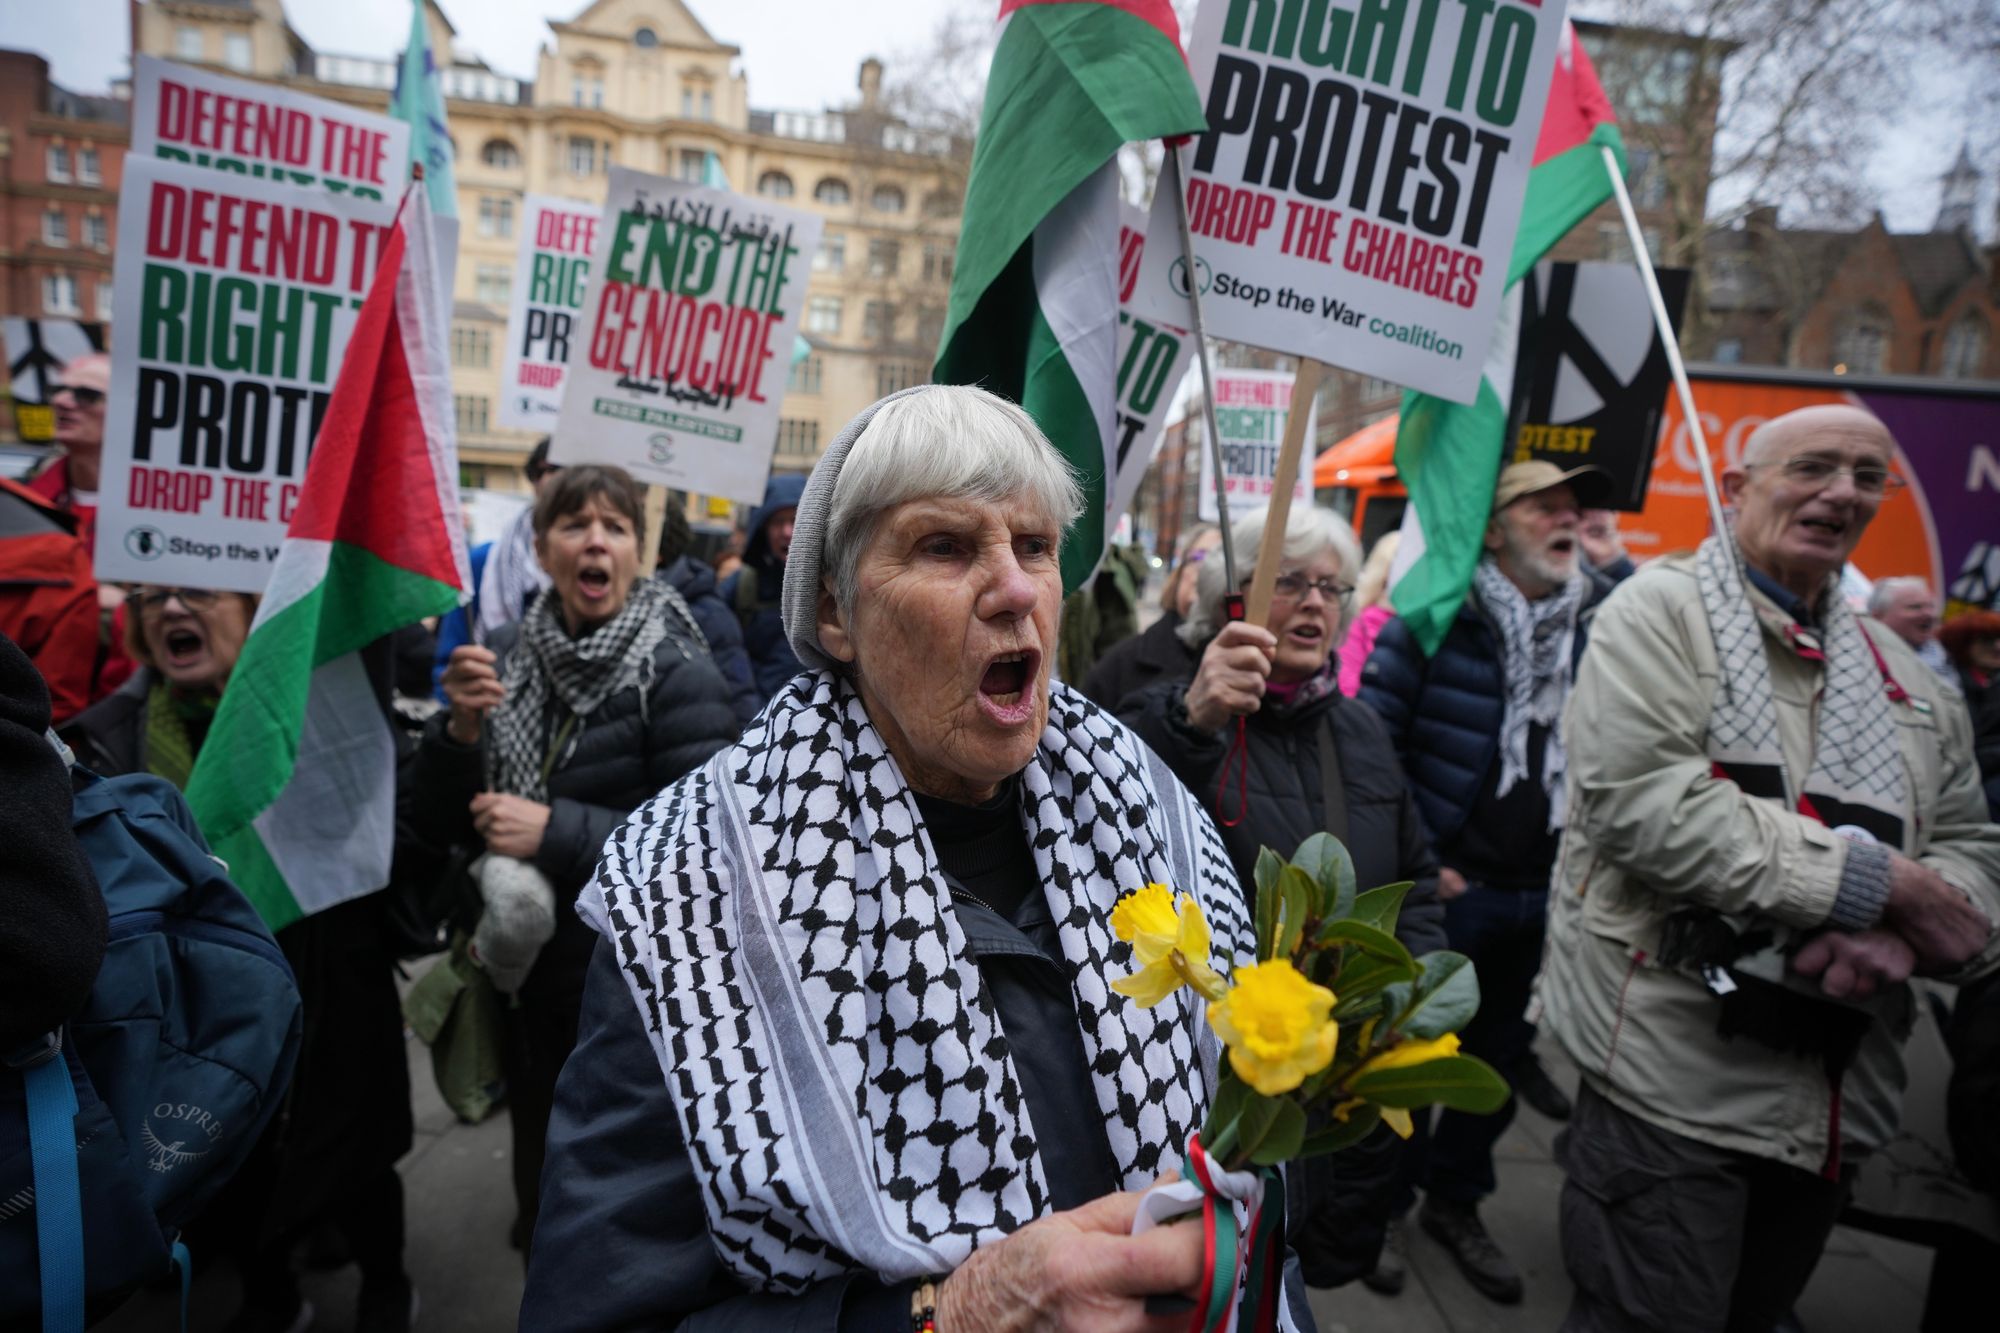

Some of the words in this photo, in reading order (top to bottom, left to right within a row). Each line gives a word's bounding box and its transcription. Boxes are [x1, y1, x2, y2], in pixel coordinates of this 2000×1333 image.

[1444, 0, 1536, 128] TO
[157, 79, 312, 167] DEFEND
[321, 117, 390, 185] THE
[1193, 53, 1511, 249] PROTEST
[145, 181, 340, 287] DEFEND
[530, 253, 590, 309] RIG
[536, 208, 599, 255] DEFE
[606, 212, 722, 297] END
[727, 232, 798, 317] THE
[1187, 177, 1276, 246] DROP
[1280, 199, 1342, 264] THE
[1343, 217, 1483, 309] CHARGES
[139, 263, 343, 384] RIGHT
[588, 279, 785, 404] GENOCIDE
[1213, 272, 1271, 308] Stop
[1276, 287, 1315, 314] the
[1321, 295, 1367, 329] War
[1368, 316, 1464, 360] coalition
[132, 367, 332, 477] PROT
[1219, 443, 1278, 478] PROTE
[1518, 422, 1596, 453] OTEST
[128, 466, 213, 514] DROP
[222, 477, 271, 523] THE
[169, 536, 221, 561] Stop
[227, 544, 262, 560] the
[153, 1103, 223, 1143] OSPREY
